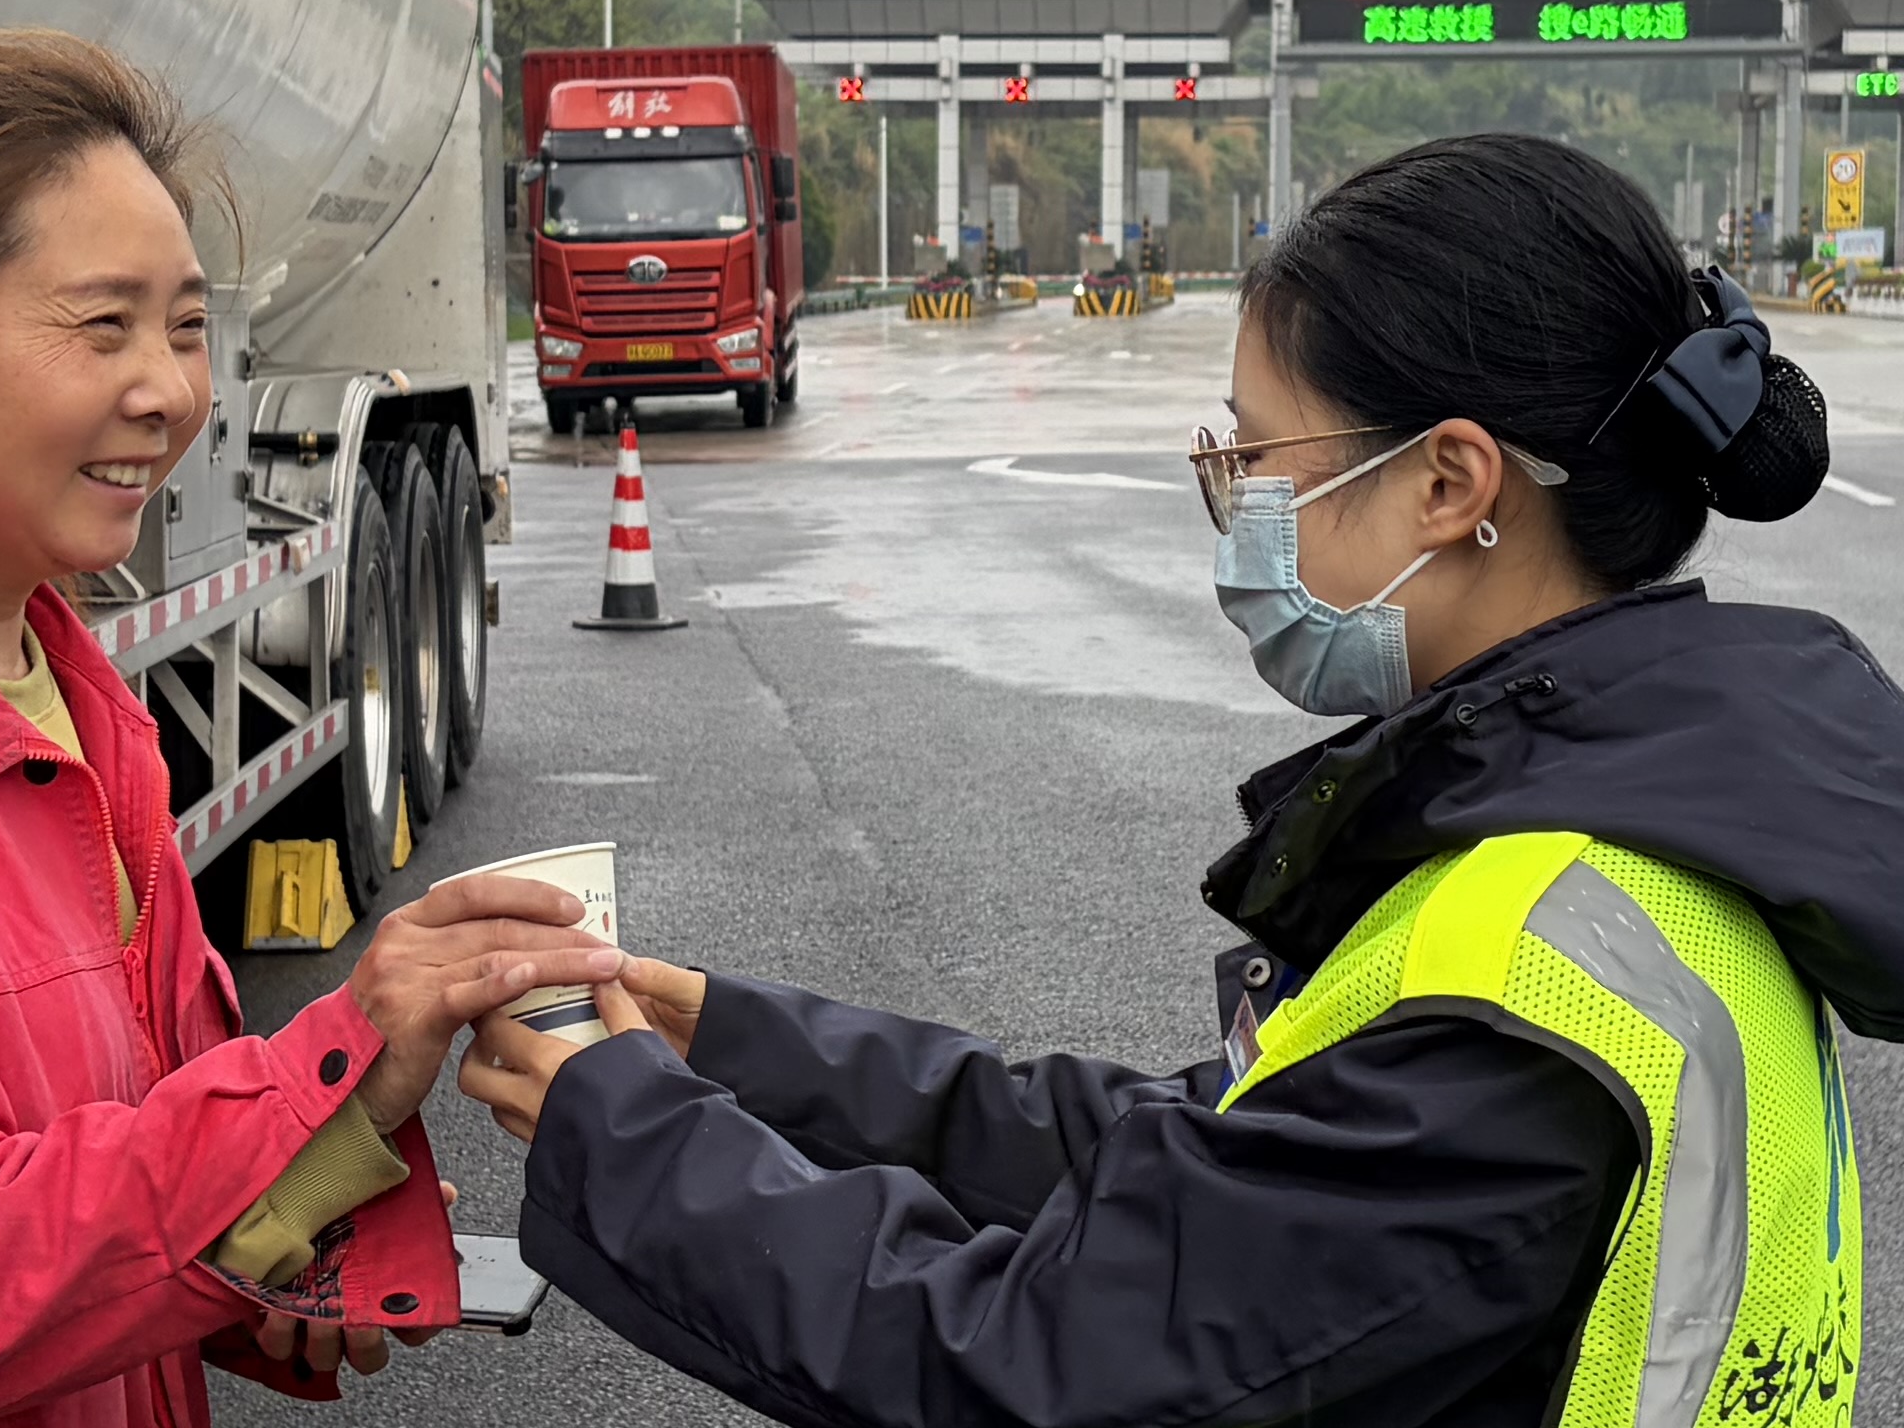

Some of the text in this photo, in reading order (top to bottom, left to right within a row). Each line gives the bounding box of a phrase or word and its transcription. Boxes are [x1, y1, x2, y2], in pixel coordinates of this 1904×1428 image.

[1363, 3, 1494, 43] 高速救援
[1856, 72, 1899, 97] ETC
